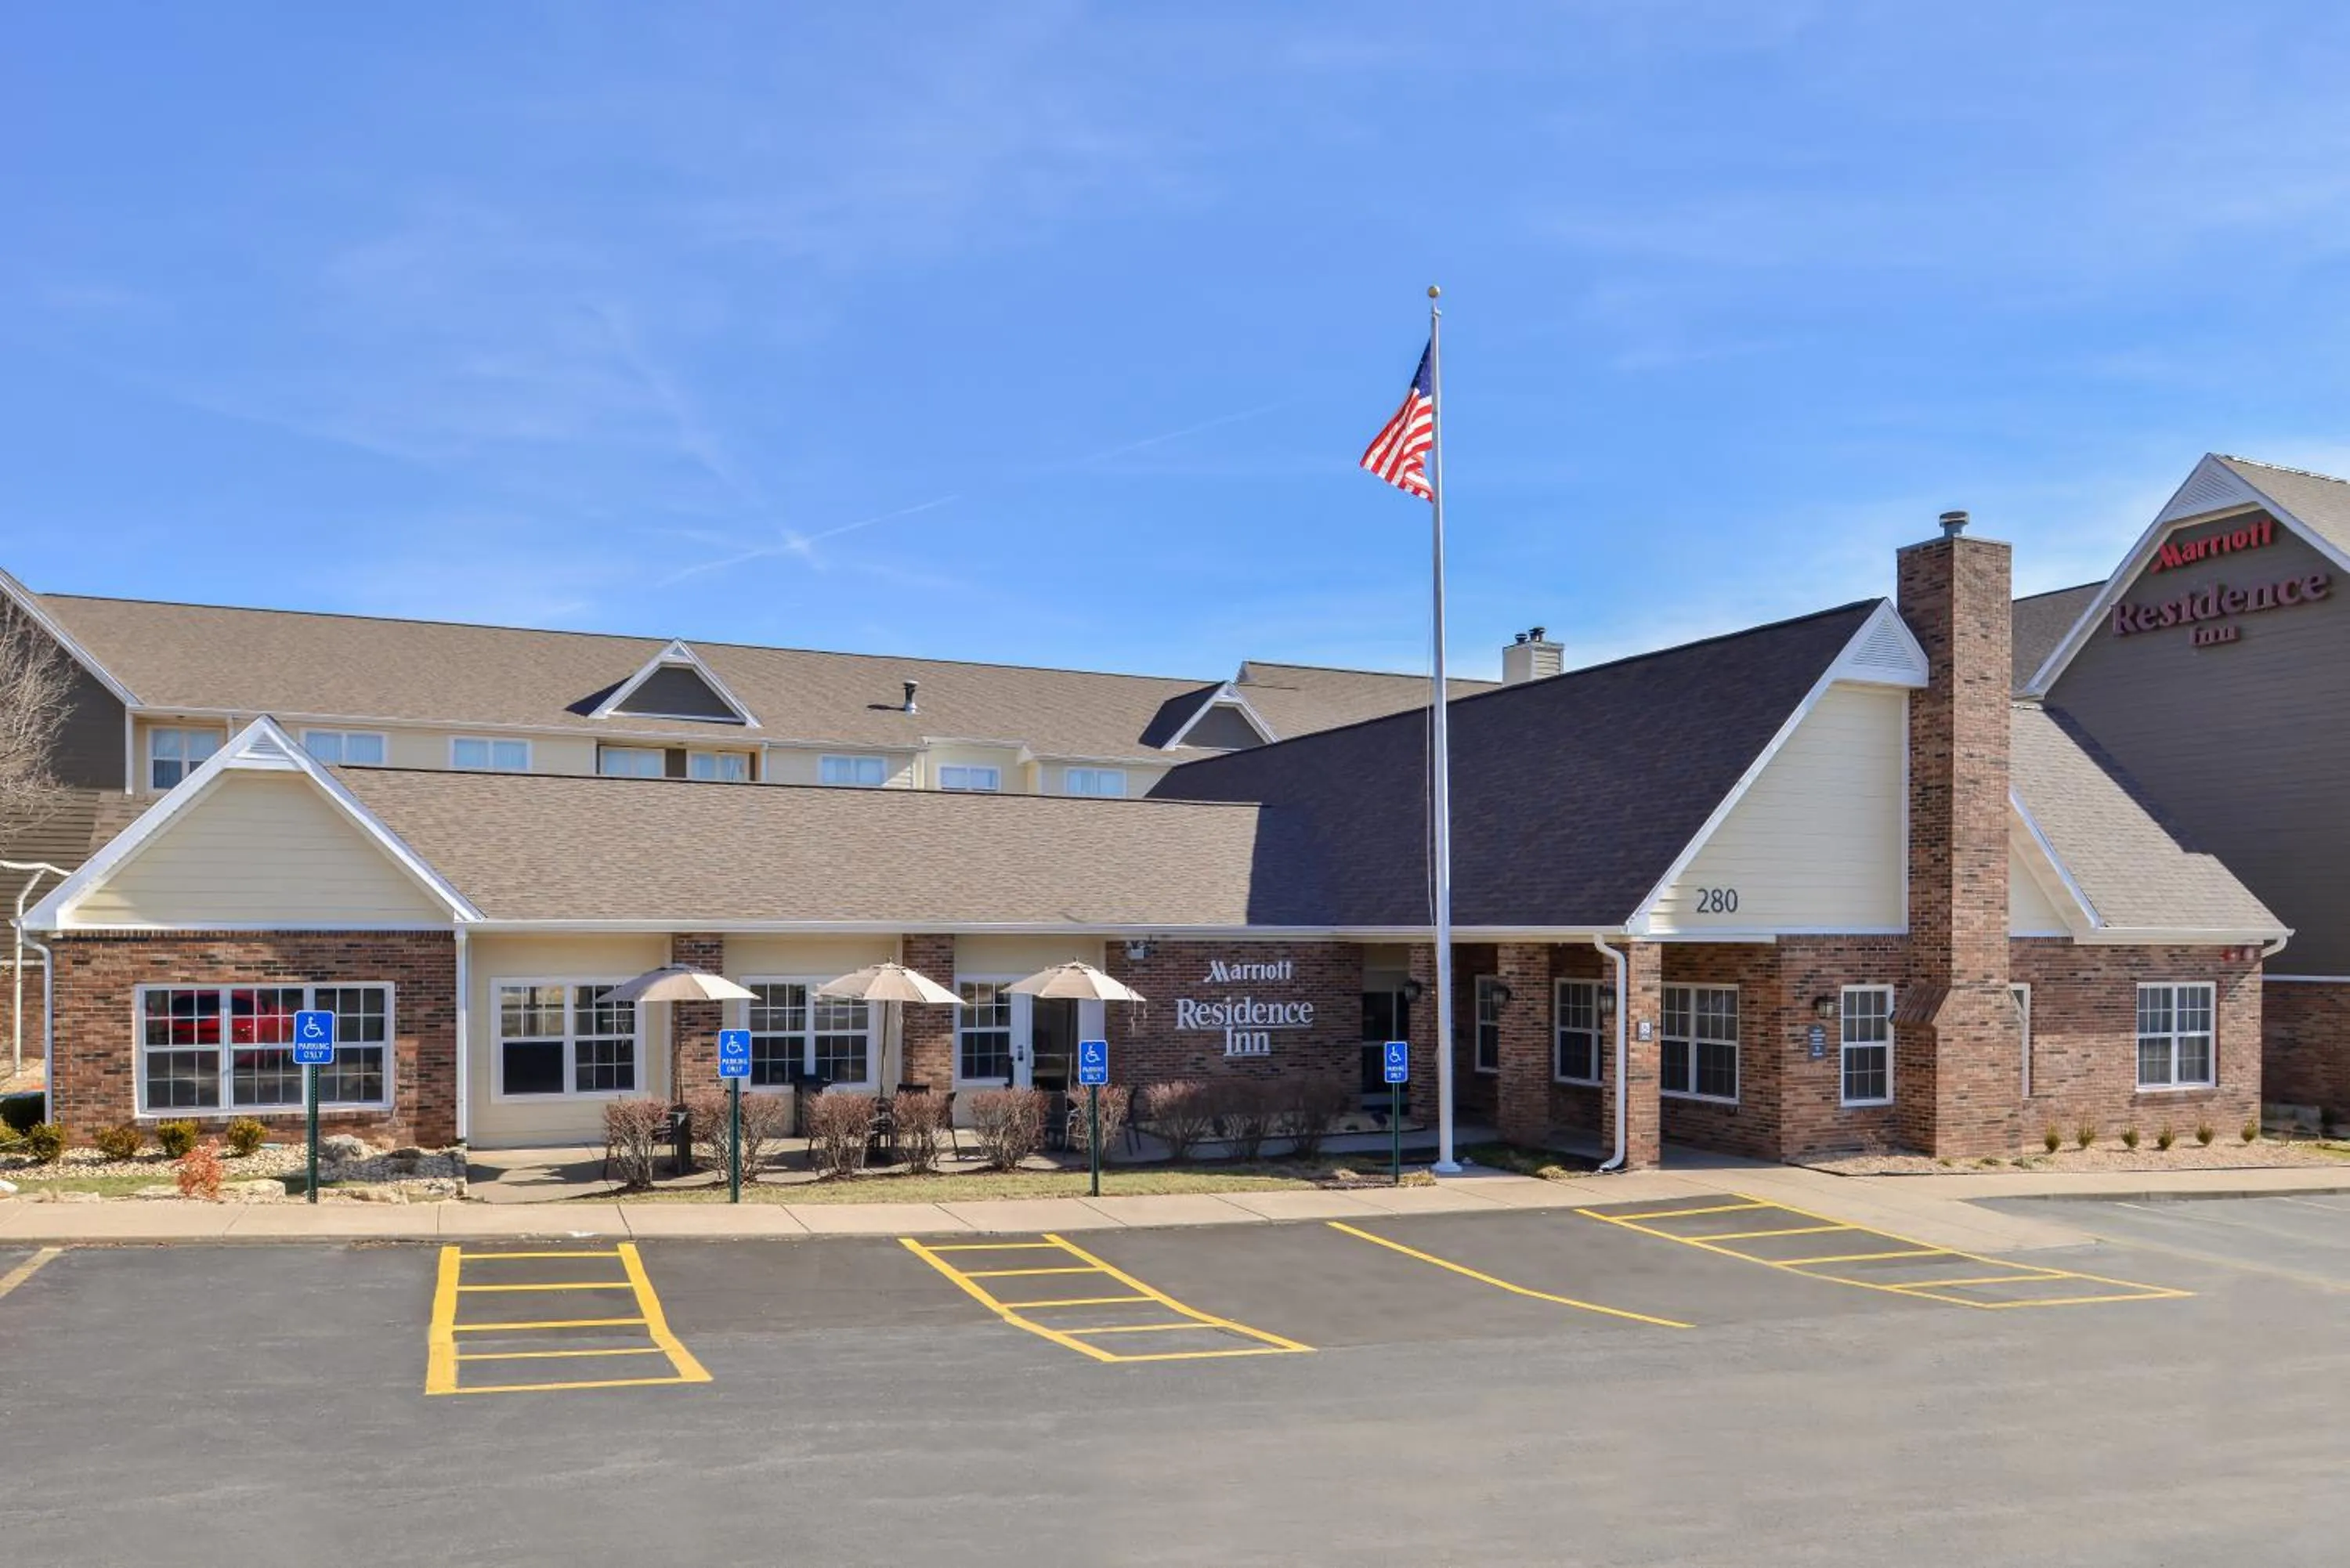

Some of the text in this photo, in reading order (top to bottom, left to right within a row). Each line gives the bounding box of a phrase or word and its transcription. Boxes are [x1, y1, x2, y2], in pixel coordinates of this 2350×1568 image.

[2149, 520, 2272, 573] Marriott
[2113, 570, 2330, 635] Residence
[2189, 625, 2238, 646] Inn
[1697, 888, 1738, 913] 280
[1203, 959, 1292, 983] Marriott
[1175, 996, 1314, 1029] Residence
[1224, 1026, 1271, 1057] Inn
